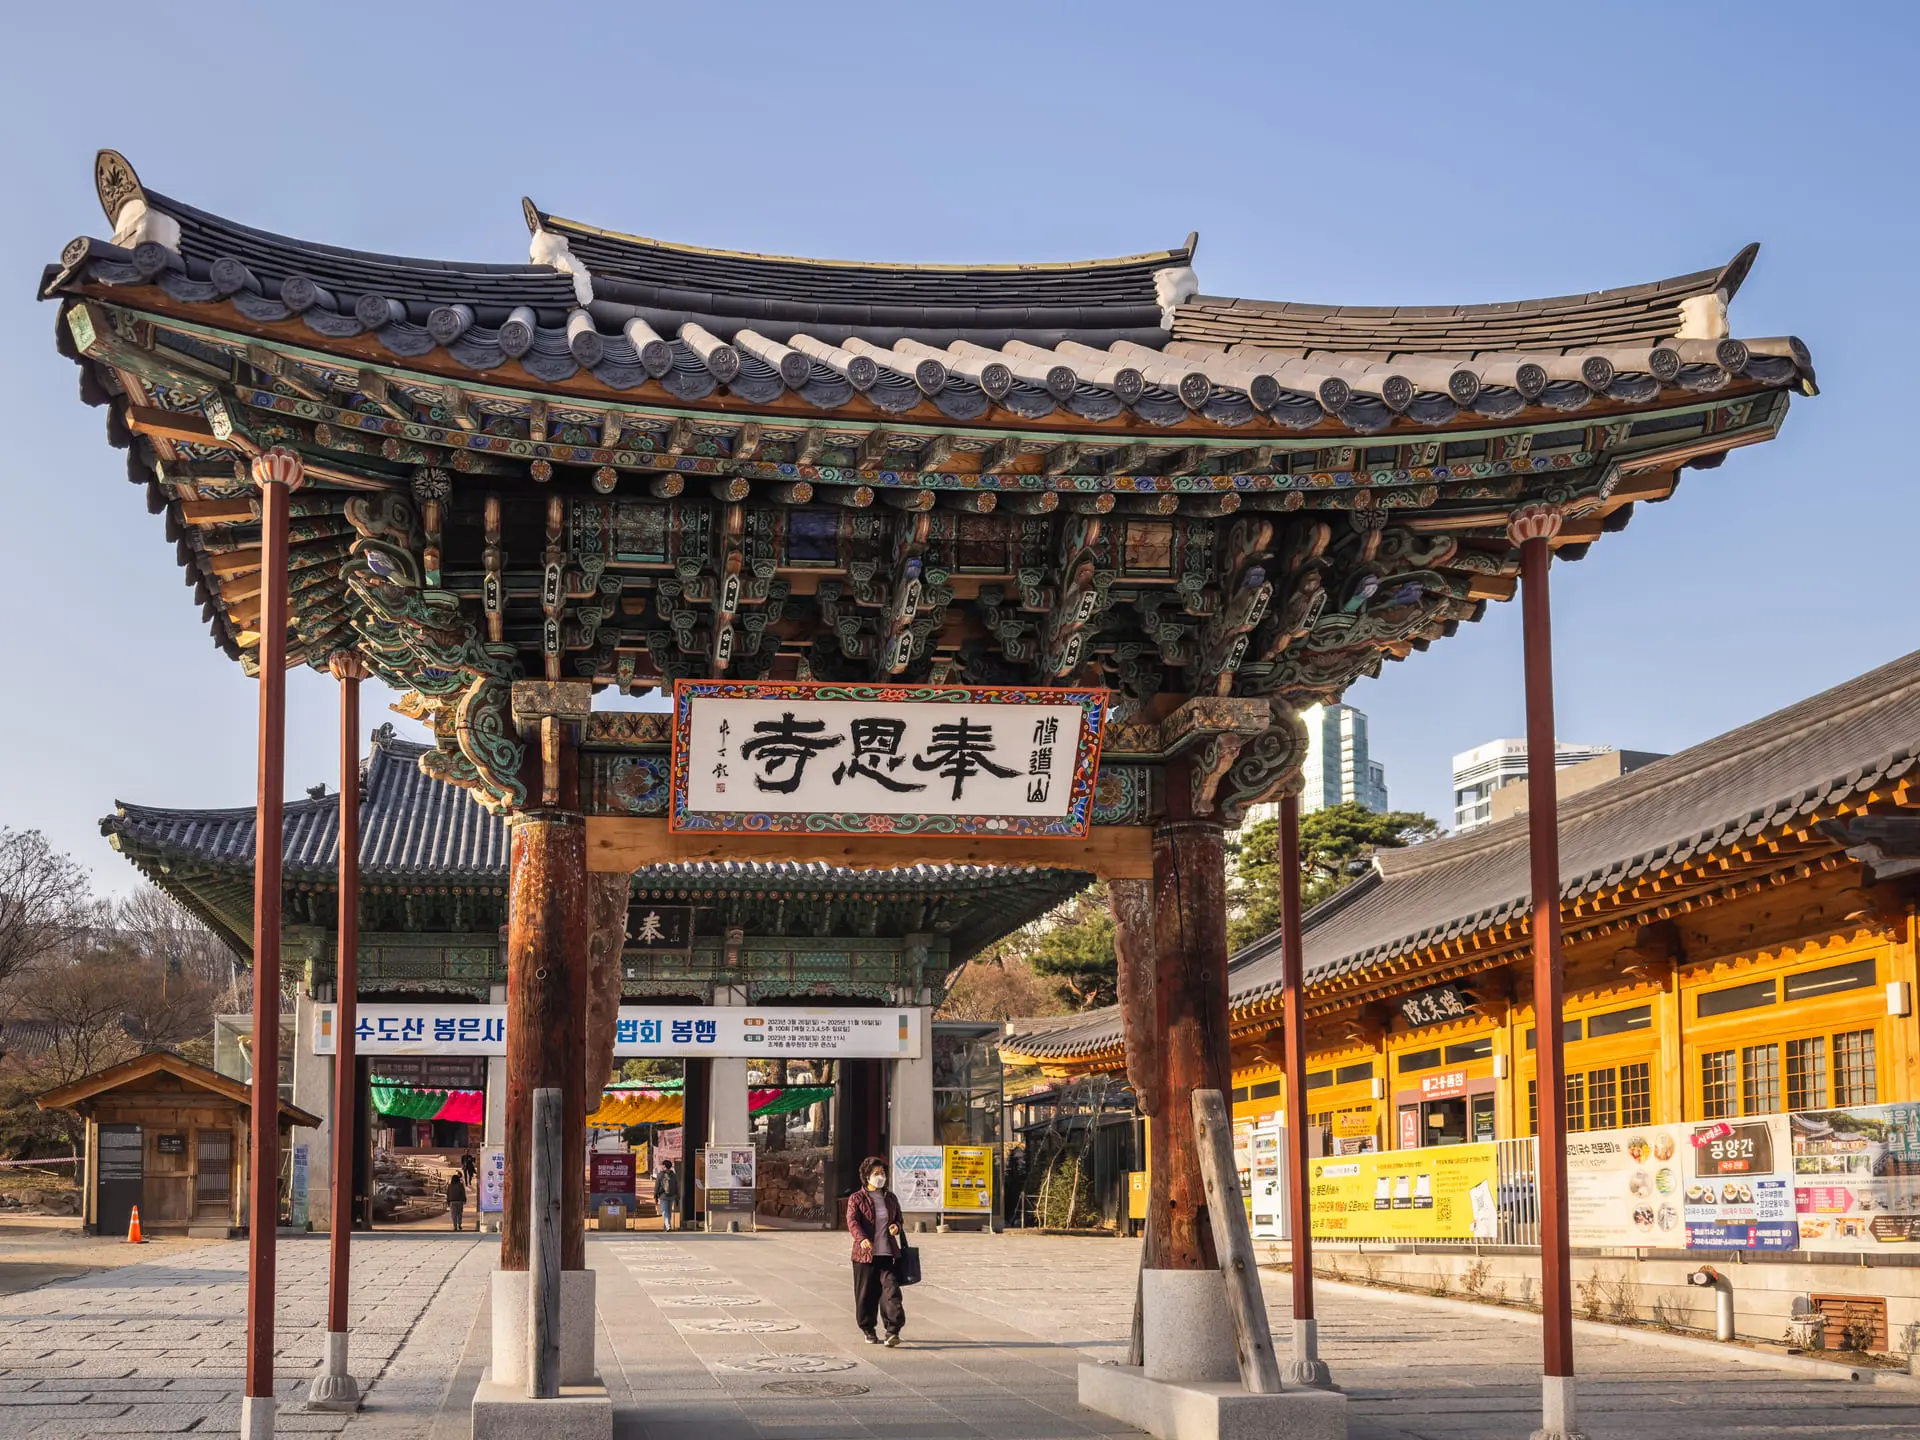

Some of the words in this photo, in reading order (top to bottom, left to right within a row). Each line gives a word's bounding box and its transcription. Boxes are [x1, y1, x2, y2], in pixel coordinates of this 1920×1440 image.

[739, 711, 1025, 801] 奉恩寺
[355, 1017, 424, 1042] 수도산
[434, 1018, 504, 1043] 봉은사
[617, 1019, 662, 1043] 법회
[671, 1019, 717, 1043] 봉행
[1710, 1138, 1754, 1159] 공양간
